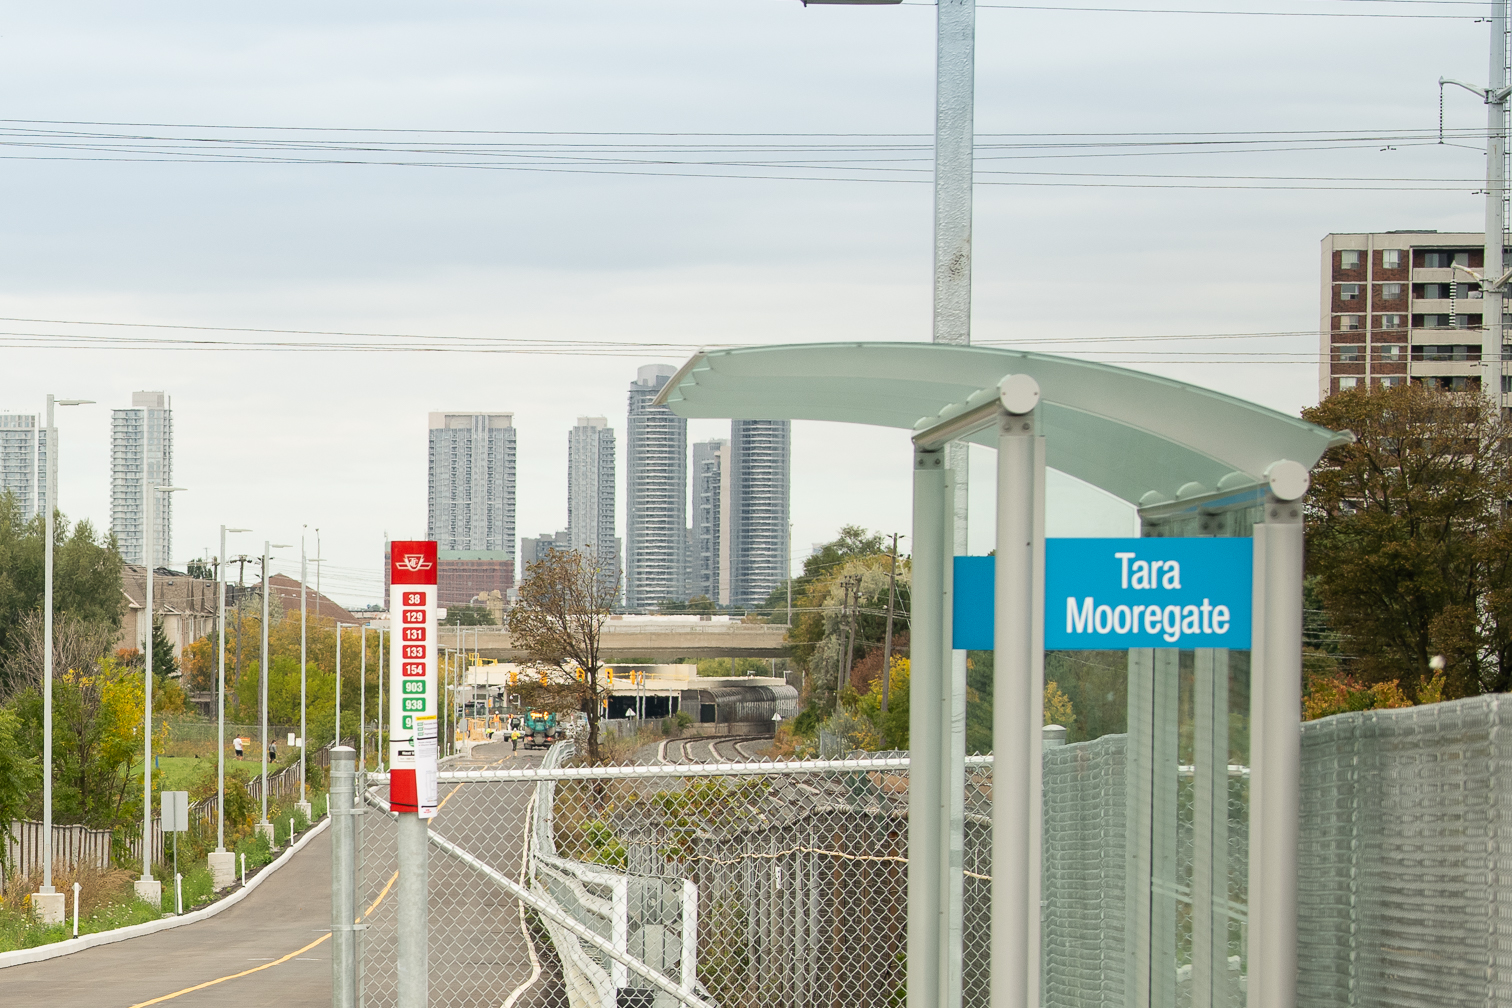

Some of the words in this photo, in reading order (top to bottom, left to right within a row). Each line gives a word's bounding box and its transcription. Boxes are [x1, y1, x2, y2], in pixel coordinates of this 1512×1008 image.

[1115, 552, 1181, 589] Tara
[408, 594, 420, 604] 38
[405, 612, 423, 622] 129
[1066, 597, 1230, 642] Mooregate
[405, 629, 422, 639] 131
[405, 647, 423, 657] 133
[405, 664, 423, 675] 154
[405, 682, 423, 692] 903
[405, 699, 423, 710] 938
